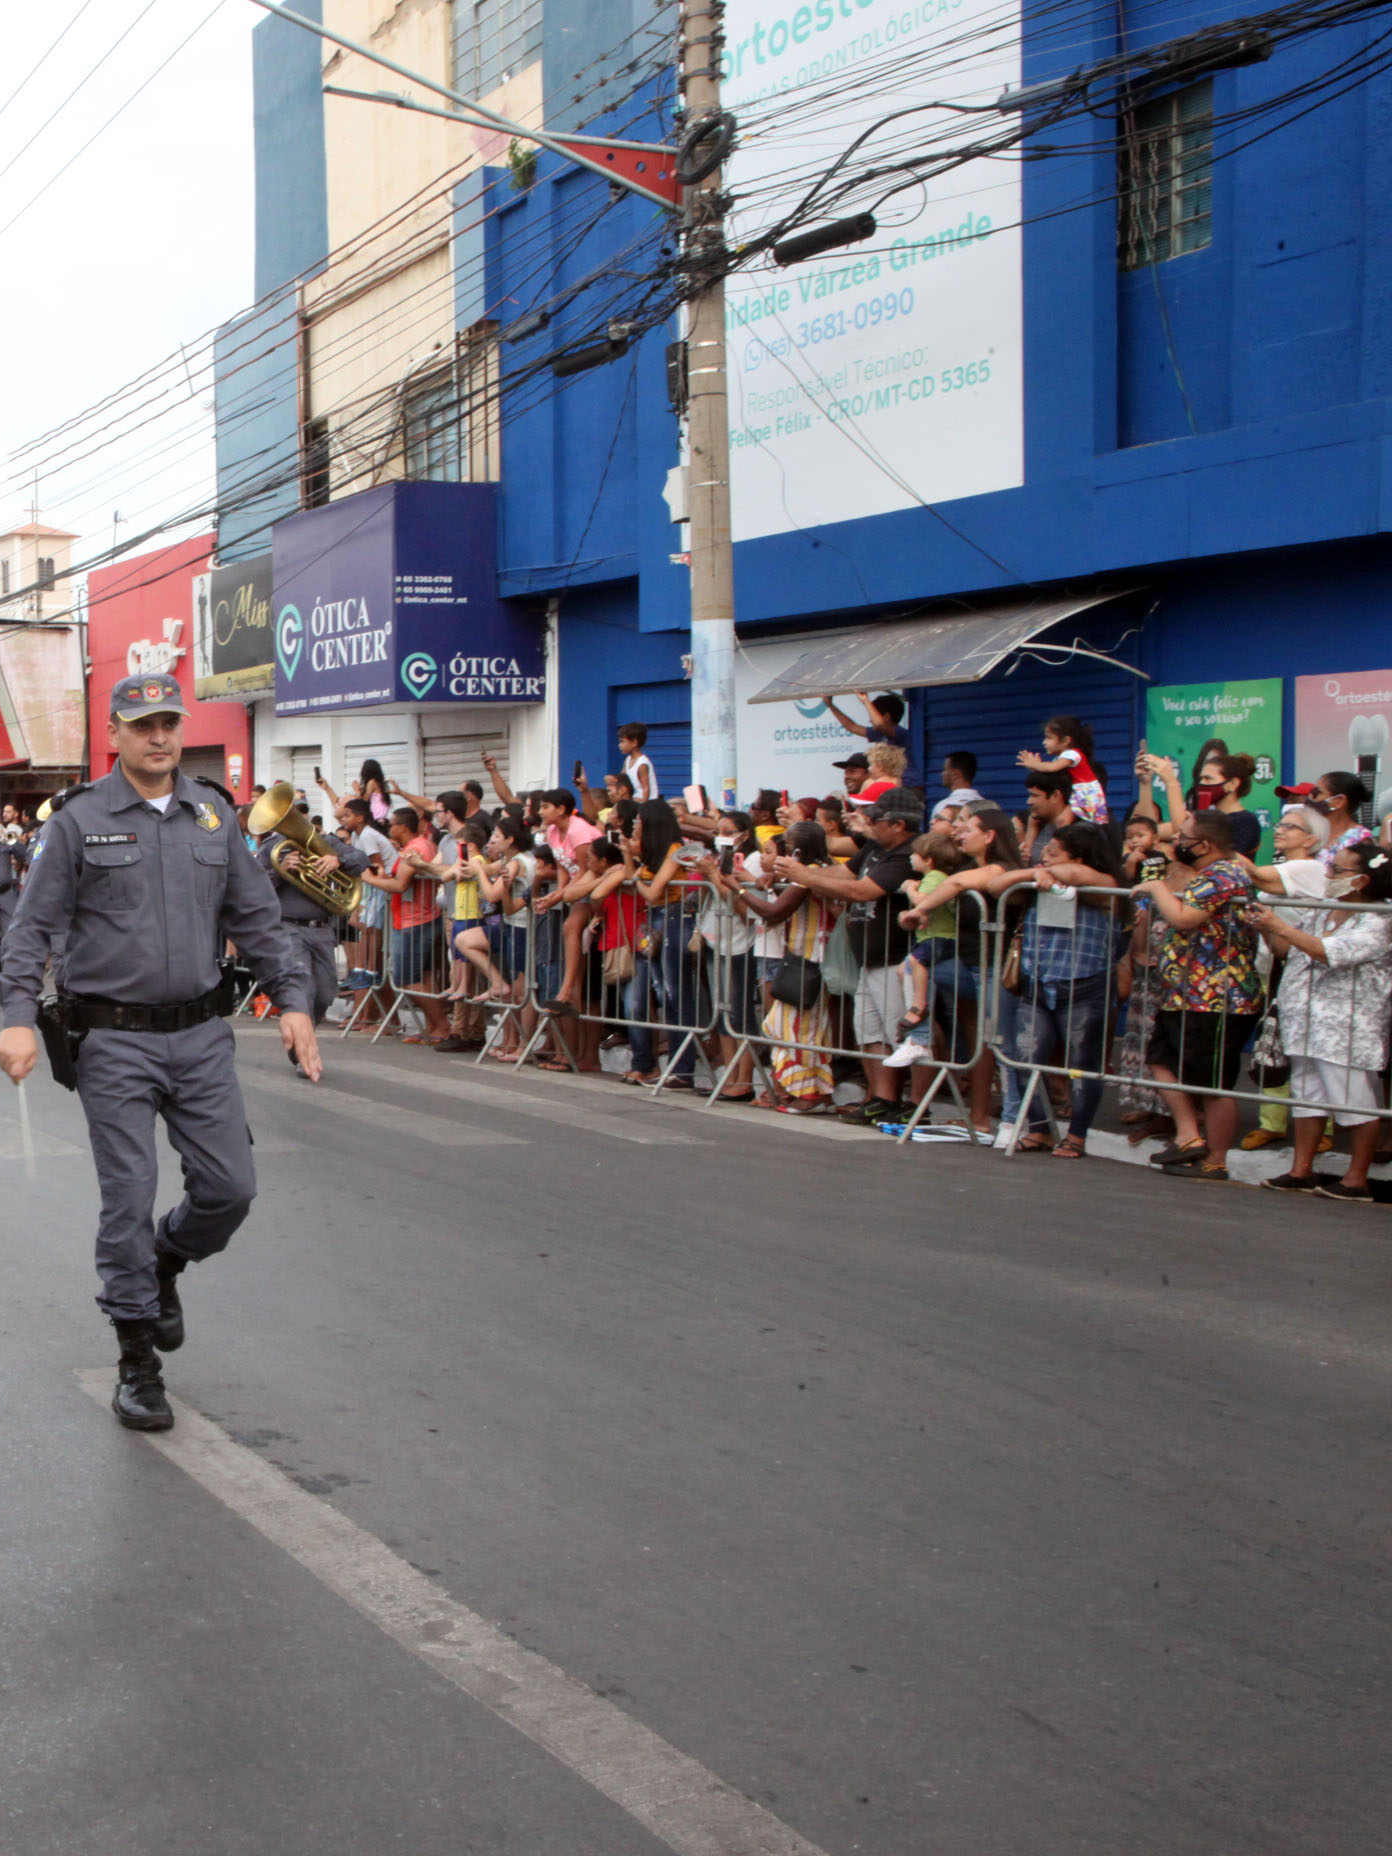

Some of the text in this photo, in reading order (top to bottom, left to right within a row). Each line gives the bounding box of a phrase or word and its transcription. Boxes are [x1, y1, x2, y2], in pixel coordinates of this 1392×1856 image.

[797, 254, 881, 304] Várzea
[889, 211, 993, 274] Grande
[796, 286, 915, 351] 3681-0990
[746, 346, 929, 416] Responsável Técnico:
[728, 423, 772, 450] Felipe
[776, 412, 812, 438] Félix
[827, 375, 936, 423] CRO/MT-CD
[940, 358, 991, 394] 5365
[311, 596, 371, 637] ÓTICA
[311, 630, 388, 672] CENTER
[449, 651, 521, 676] ÓTICA
[449, 677, 541, 696] CENTER
[1162, 694, 1265, 713] Você está feliz com
[1185, 715, 1203, 727] seu
[1204, 707, 1250, 726] sorriso?
